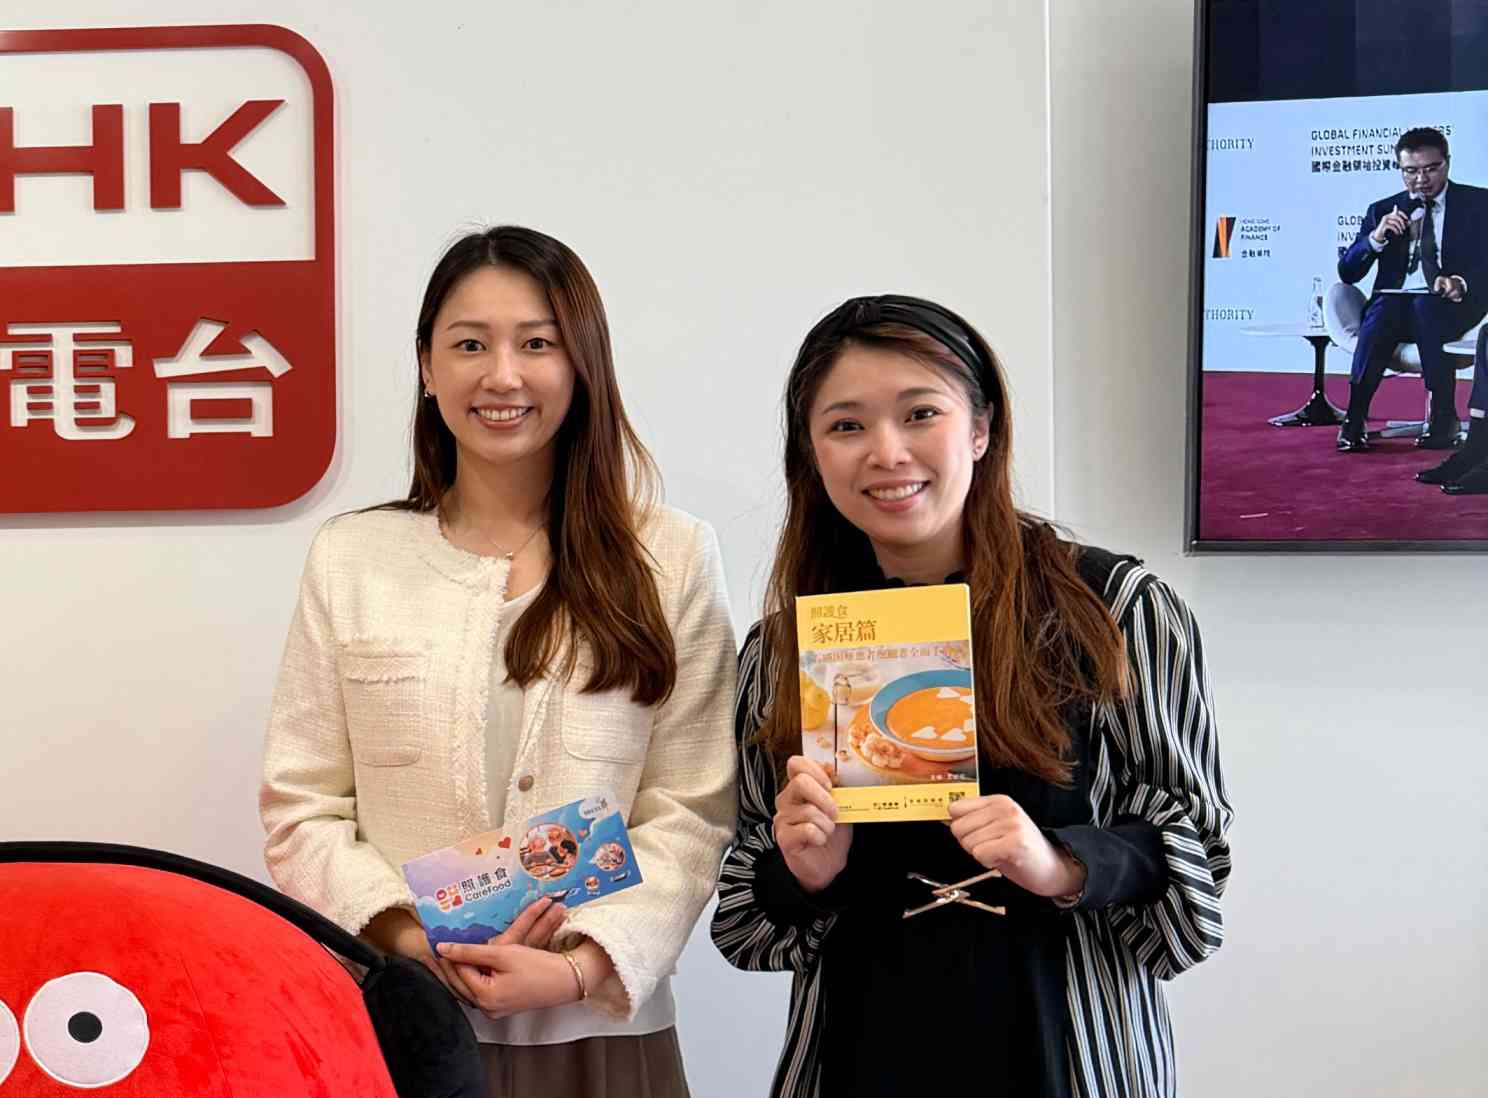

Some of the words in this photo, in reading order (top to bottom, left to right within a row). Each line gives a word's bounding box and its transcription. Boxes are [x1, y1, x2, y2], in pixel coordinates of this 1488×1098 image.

[1311, 130, 1350, 141] GLOBAL
[1311, 144, 1374, 157] INVESTMENT
[811, 619, 877, 643] 家居篇
[461, 867, 508, 893] 照護食
[464, 879, 512, 901] CareFood
